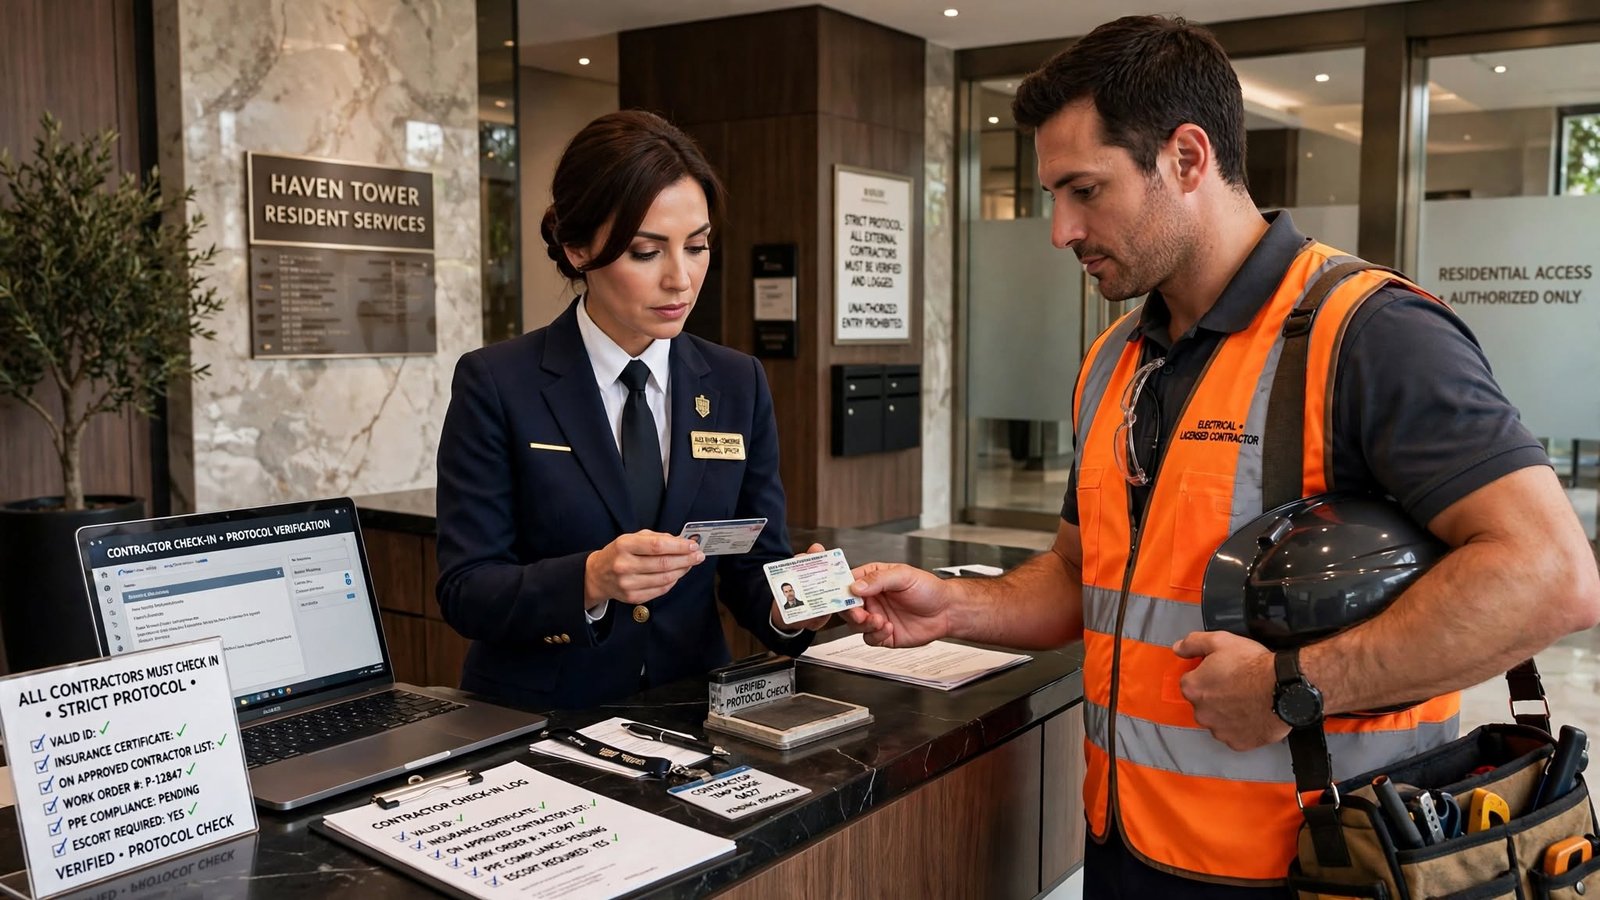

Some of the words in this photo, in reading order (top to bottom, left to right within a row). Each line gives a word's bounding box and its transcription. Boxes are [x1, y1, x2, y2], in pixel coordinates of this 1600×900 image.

[271, 174, 343, 199] HAVEN
[351, 181, 419, 206] TOWER
[265, 205, 349, 227] RESIDENT
[354, 212, 425, 232] SERVICES
[845, 214, 867, 226] STRICT
[851, 231, 862, 242] ALL
[864, 232, 897, 245] EXTERNAL
[850, 246, 897, 259] CONTRACTORS
[845, 261, 863, 271] MUST
[866, 262, 874, 273] BE
[875, 262, 901, 274] VERIFIED
[1439, 267, 1529, 281] RESIDENTIAL
[1535, 265, 1592, 280] ACCESS
[851, 276, 866, 286] AND
[849, 303, 897, 314] UNAUTHORIZED
[1450, 291, 1538, 304] AUTHORIZED
[1543, 290, 1582, 304] ONLY
[842, 318, 862, 328] ENTRY
[1198, 420, 1236, 430] ELECTRICAL
[1180, 431, 1208, 441] LICENSED
[1210, 433, 1259, 445] CONTRACTOR
[108, 540, 172, 559] CONTRACTOR
[174, 534, 216, 550] CHECK-IN
[226, 527, 272, 542] PROTOCOL
[275, 519, 330, 536] VERIFICATION
[19, 688, 46, 707] ALL
[50, 669, 144, 699] CONTRACTORS
[146, 663, 173, 682] MUST
[176, 658, 206, 676] CHECK
[208, 655, 219, 666] IN
[735, 679, 766, 694] VERIFIED
[58, 694, 108, 718] STRICT
[114, 679, 186, 706] PROTOCOL
[727, 694, 764, 708] PROTOCOL
[767, 684, 789, 698] CHECK
[50, 730, 80, 747] VALID
[83, 729, 96, 740] ID:
[54, 745, 112, 768] INSURANCE
[114, 730, 174, 754] CERTIFICATE:
[59, 777, 75, 789] ON
[78, 762, 128, 784] APPROVED
[131, 746, 192, 768] CONTRACTOR
[194, 741, 214, 754] LIST:
[63, 793, 95, 810] WORK
[97, 782, 130, 800] ORDER
[134, 780, 143, 790] #:
[145, 769, 182, 788] P-12847
[691, 774, 753, 795] CONTRACTOR
[709, 789, 732, 799] TEMP
[68, 815, 87, 830] PPE
[90, 797, 156, 823] COMPLIANCE:
[158, 784, 200, 804] PENDING
[372, 803, 451, 829] CONTRACTOR
[451, 787, 504, 805] CHECK-IN
[503, 780, 529, 790] LOG
[725, 801, 757, 813] PENDING
[72, 831, 111, 851] ESCORT
[114, 816, 165, 837] REQUIRED:
[167, 809, 185, 822] YES
[410, 824, 440, 837] VALID
[441, 820, 456, 828] ID:
[427, 825, 484, 846] INSURANCE
[481, 807, 538, 828] CERTIFICATE:
[446, 846, 462, 854] ON
[463, 830, 511, 849] APPROVED
[512, 810, 569, 832] CONTRACTOR
[567, 804, 591, 815] LIST:
[56, 852, 115, 880] VERIFIED
[128, 828, 194, 858] PROTOCOL
[196, 815, 234, 836] CHECK
[464, 851, 498, 863] WORK
[495, 839, 530, 852] ORDER
[482, 861, 505, 872] PPE
[504, 839, 567, 865] COMPLIANCE:
[566, 826, 607, 842] PENDING
[504, 863, 545, 881] ESCORT
[589, 840, 610, 848] YES
